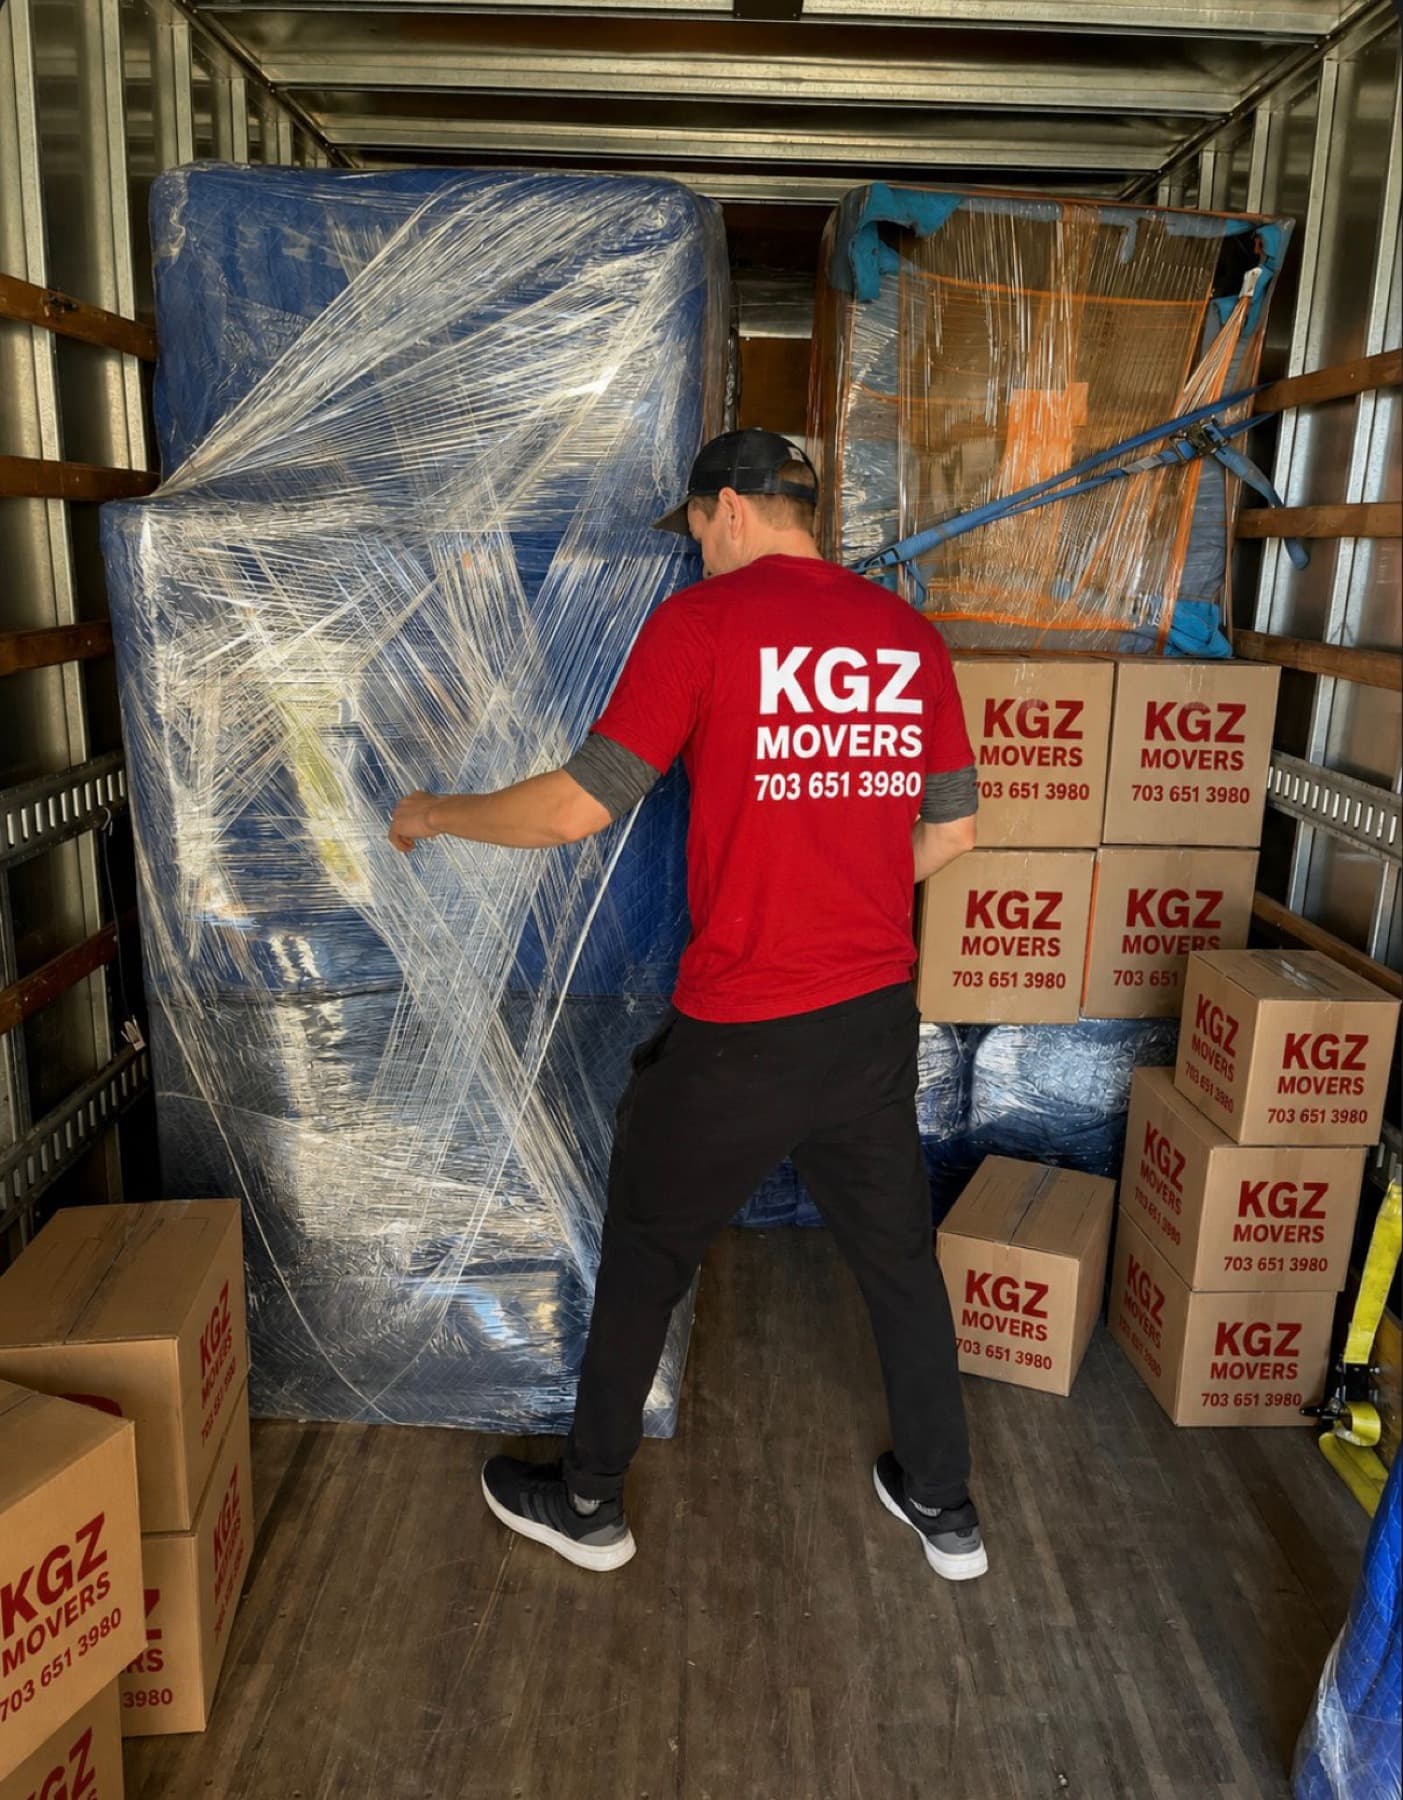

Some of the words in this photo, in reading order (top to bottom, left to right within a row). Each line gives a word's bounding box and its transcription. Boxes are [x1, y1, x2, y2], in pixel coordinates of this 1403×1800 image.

[759, 646, 923, 715] KGZ
[983, 698, 1084, 740] KGZ
[1144, 701, 1246, 744] KGZ
[756, 724, 922, 760] MOVERS
[979, 744, 1083, 767] MOVERS
[1140, 748, 1245, 771] MOVERS
[754, 772, 801, 802] 703
[808, 771, 851, 798] 651
[857, 771, 922, 798] 3980
[1008, 781, 1039, 800] 651
[1045, 782, 1090, 800] 3980
[1131, 784, 1164, 802] 703
[1169, 785, 1199, 803] 651
[1205, 786, 1250, 804] 3980
[965, 889, 1063, 930] KGZ
[1125, 888, 1224, 929] KGZ
[960, 935, 1061, 957] MOVERS
[1121, 934, 1221, 955] MOVERS
[952, 970, 983, 988] 703
[988, 970, 1018, 988] 651
[1023, 971, 1066, 989] 3980
[1112, 969, 1144, 986] 703
[1149, 970, 1178, 986] 651
[1195, 993, 1239, 1058] KGZ
[1191, 1033, 1235, 1082] MOVERS
[1282, 1033, 1369, 1071] KGZ
[1277, 1076, 1364, 1096] MOVERS
[1267, 1108, 1296, 1124] 703
[1299, 1108, 1326, 1124] 651
[1330, 1109, 1368, 1124] 3980
[1143, 1120, 1186, 1193] KGZ
[1139, 1159, 1182, 1216] MOVERS
[1238, 1180, 1329, 1219] KGZ
[1232, 1224, 1325, 1243] MOVERS
[1223, 1256, 1253, 1272] 703
[1257, 1256, 1284, 1272] 651
[1289, 1257, 1328, 1272] 3980
[965, 1269, 1049, 1319] KGZ
[1127, 1253, 1165, 1328] KGZ
[200, 1279, 231, 1380] KGZ
[961, 1308, 1048, 1342] MOVERS
[1214, 1321, 1302, 1357] KGZ
[985, 1344, 1011, 1362] 651
[1014, 1350, 1052, 1370] 3980
[1210, 1362, 1298, 1380] MOVERS
[1201, 1392, 1229, 1407] 703
[1233, 1392, 1260, 1407] 651
[1264, 1392, 1302, 1407] 3980
[0, 1511, 108, 1639] KGZ
[2, 1571, 111, 1678] MOVERS
[0, 1679, 35, 1723] 703
[40, 1647, 72, 1688] 651
[77, 1607, 122, 1658] 3980
[122, 1688, 173, 1708] 3980
